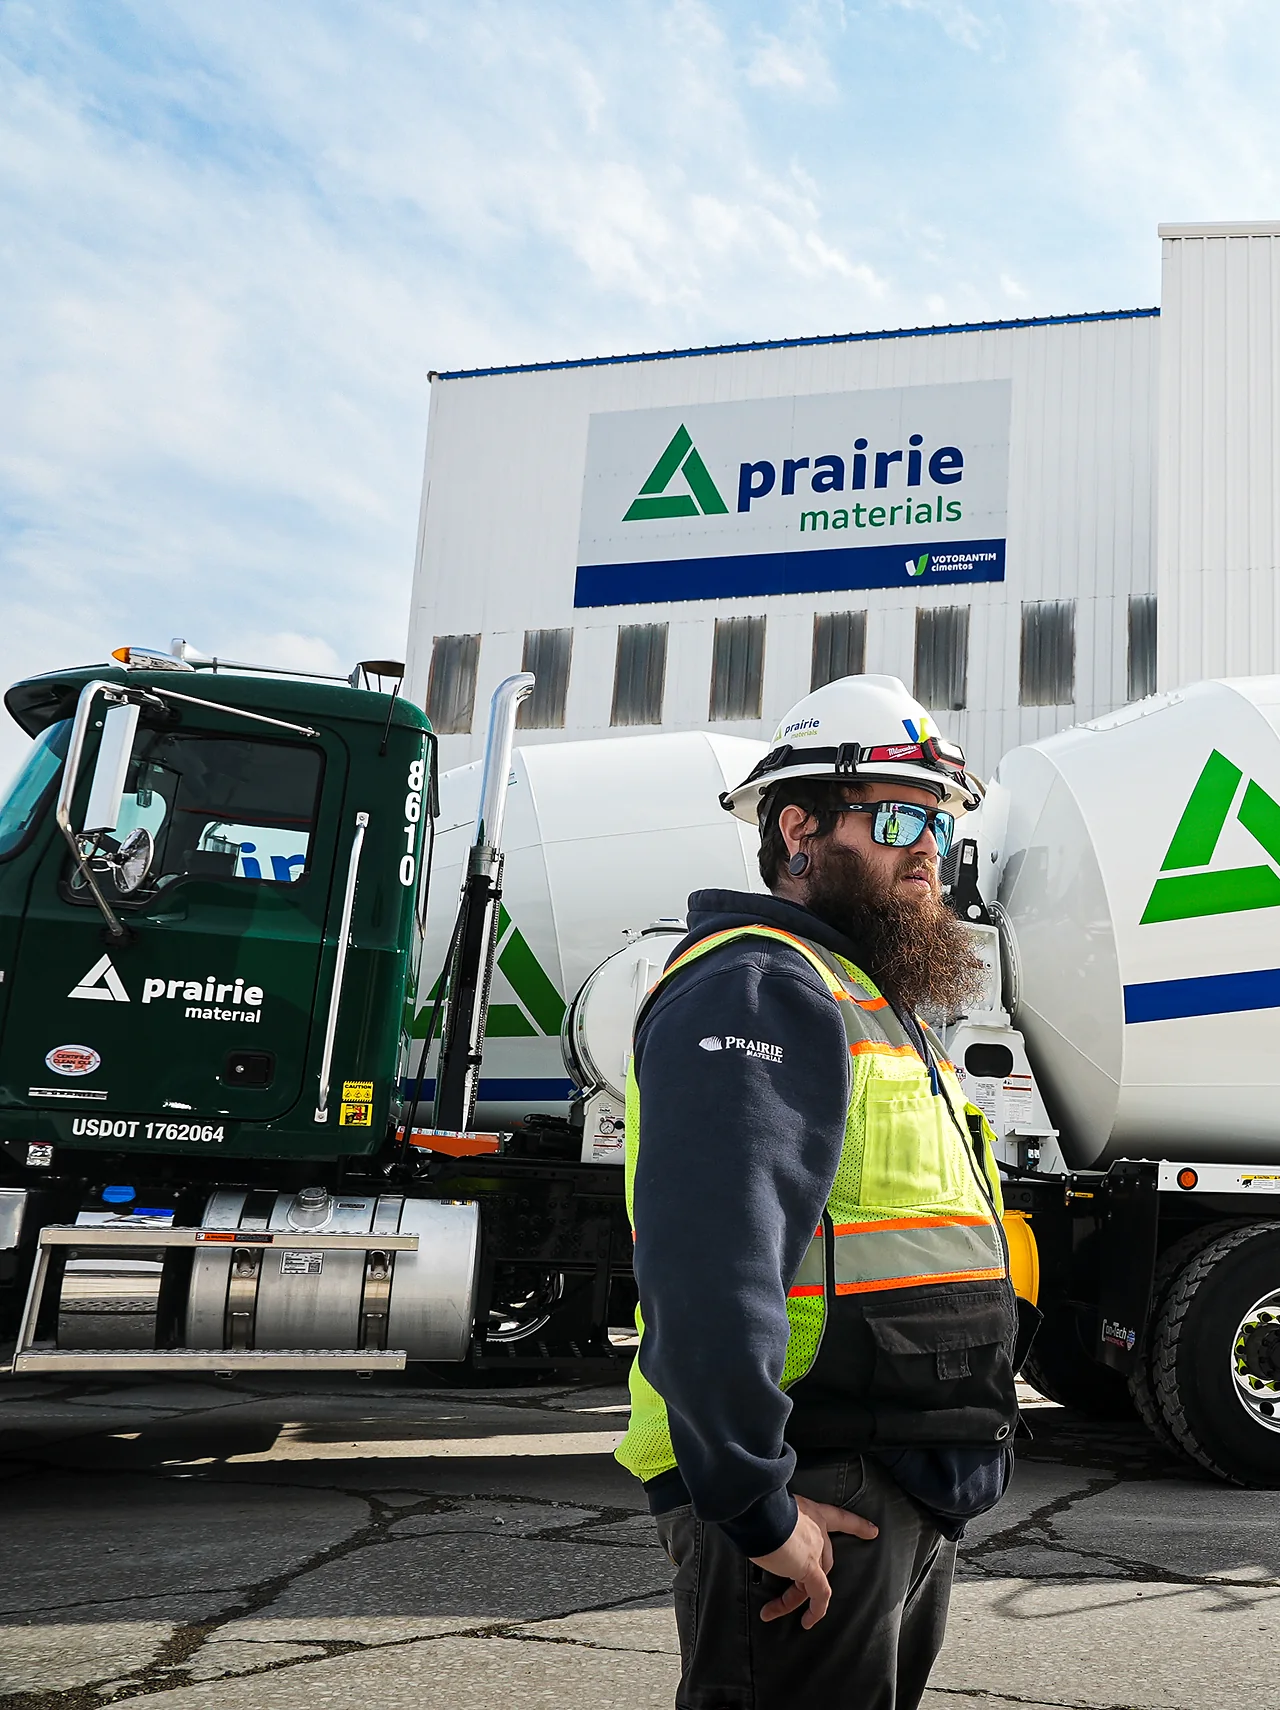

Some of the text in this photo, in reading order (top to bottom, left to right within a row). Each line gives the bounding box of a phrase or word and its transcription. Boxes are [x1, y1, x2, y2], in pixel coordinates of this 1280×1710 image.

[737, 434, 964, 513] prairie
[800, 495, 962, 531] materials
[931, 553, 997, 563] VOTORANTIM
[931, 563, 973, 572] cimentos
[784, 718, 820, 736] prairie
[399, 759, 424, 886] 8610
[142, 975, 264, 1006] prairie
[185, 1006, 261, 1023] material
[725, 1036, 783, 1058] PRAIRIE
[746, 1049, 783, 1063] MATERIAL
[72, 1118, 224, 1142] USDOT 1762064
